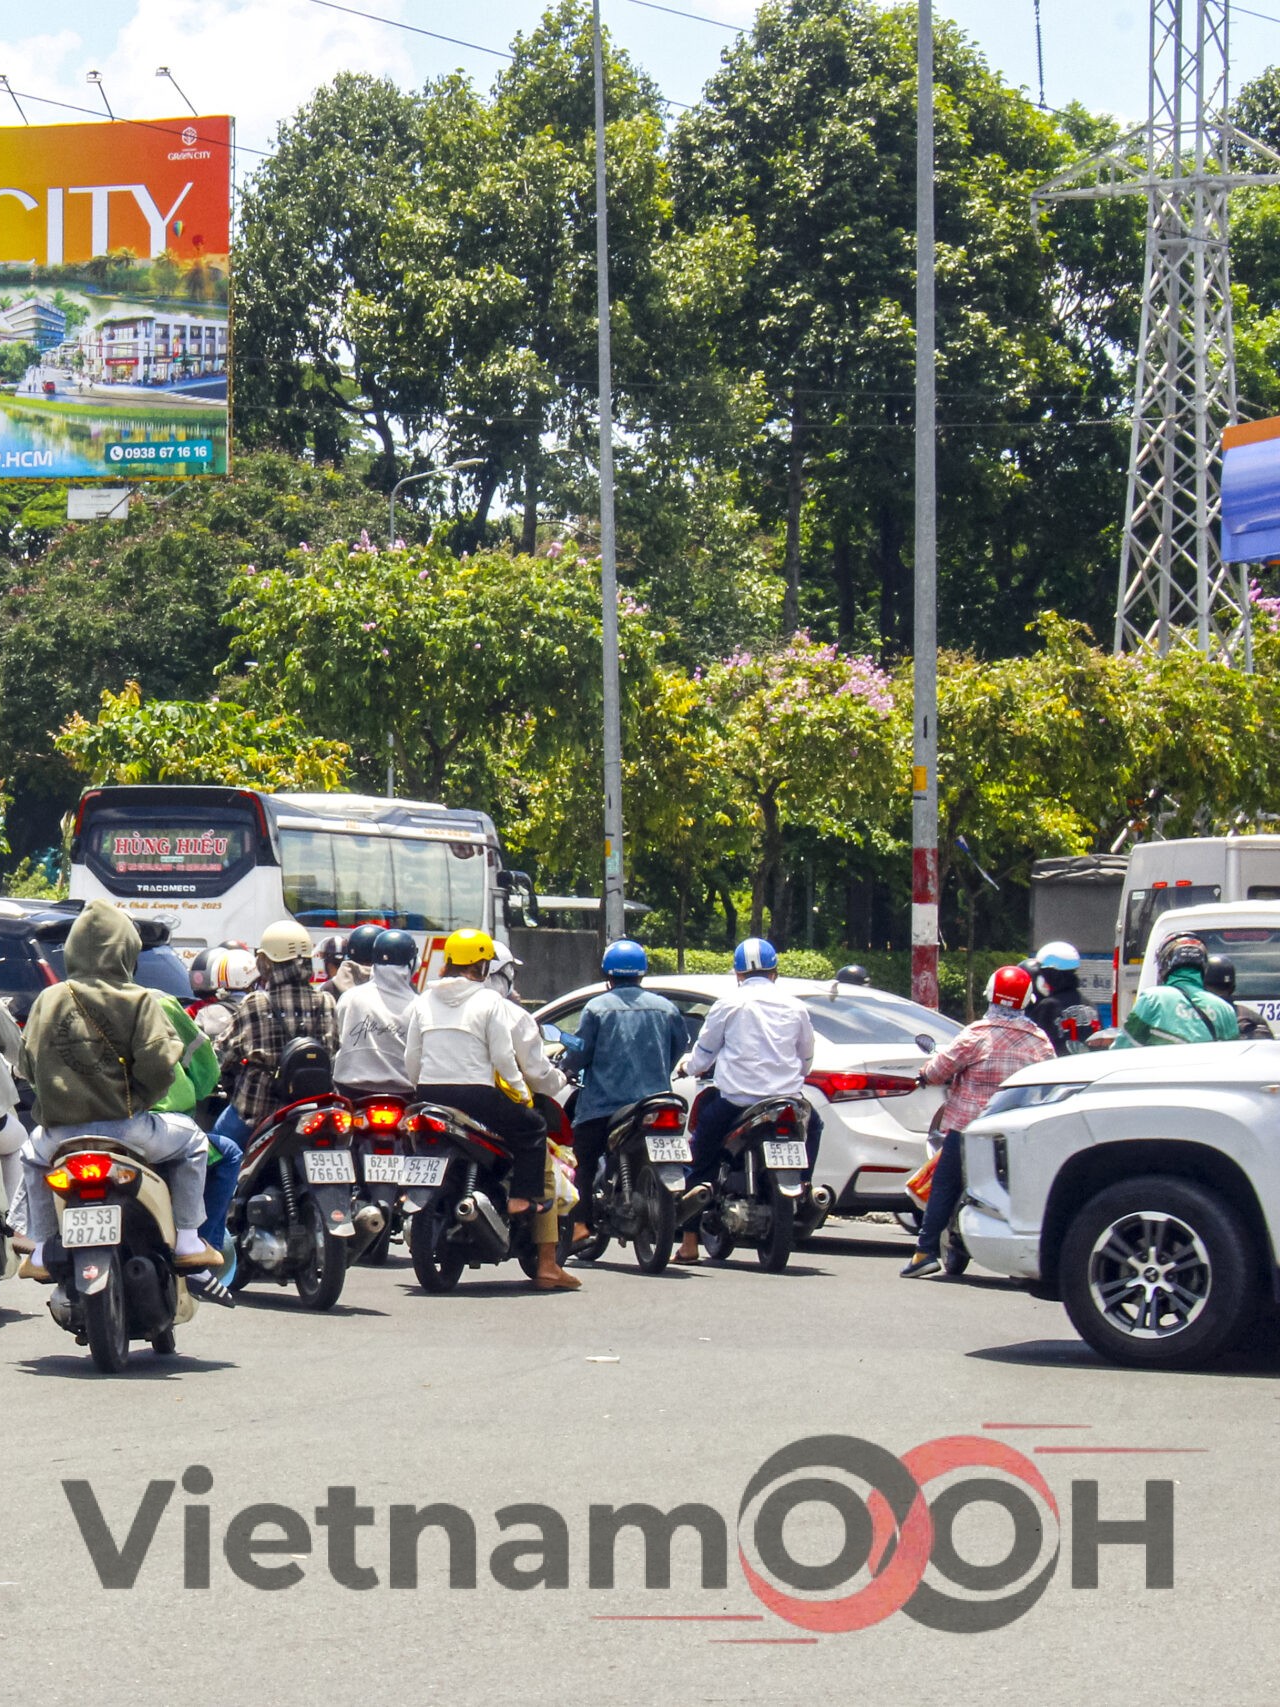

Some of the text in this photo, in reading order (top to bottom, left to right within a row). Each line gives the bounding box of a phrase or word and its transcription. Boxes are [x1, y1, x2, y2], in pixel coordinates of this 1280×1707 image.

[125, 446, 207, 459] 0938 67 16 16
[113, 829, 228, 856] HÙNG HIẾU
[137, 884, 197, 893] TRACOMECO
[311, 1154, 344, 1167] 59-L1
[409, 1160, 440, 1171] 54-H2
[405, 1172, 437, 1184] 4728
[72, 1210, 112, 1226] 59-S3
[67, 1226, 116, 1244] 287.46
